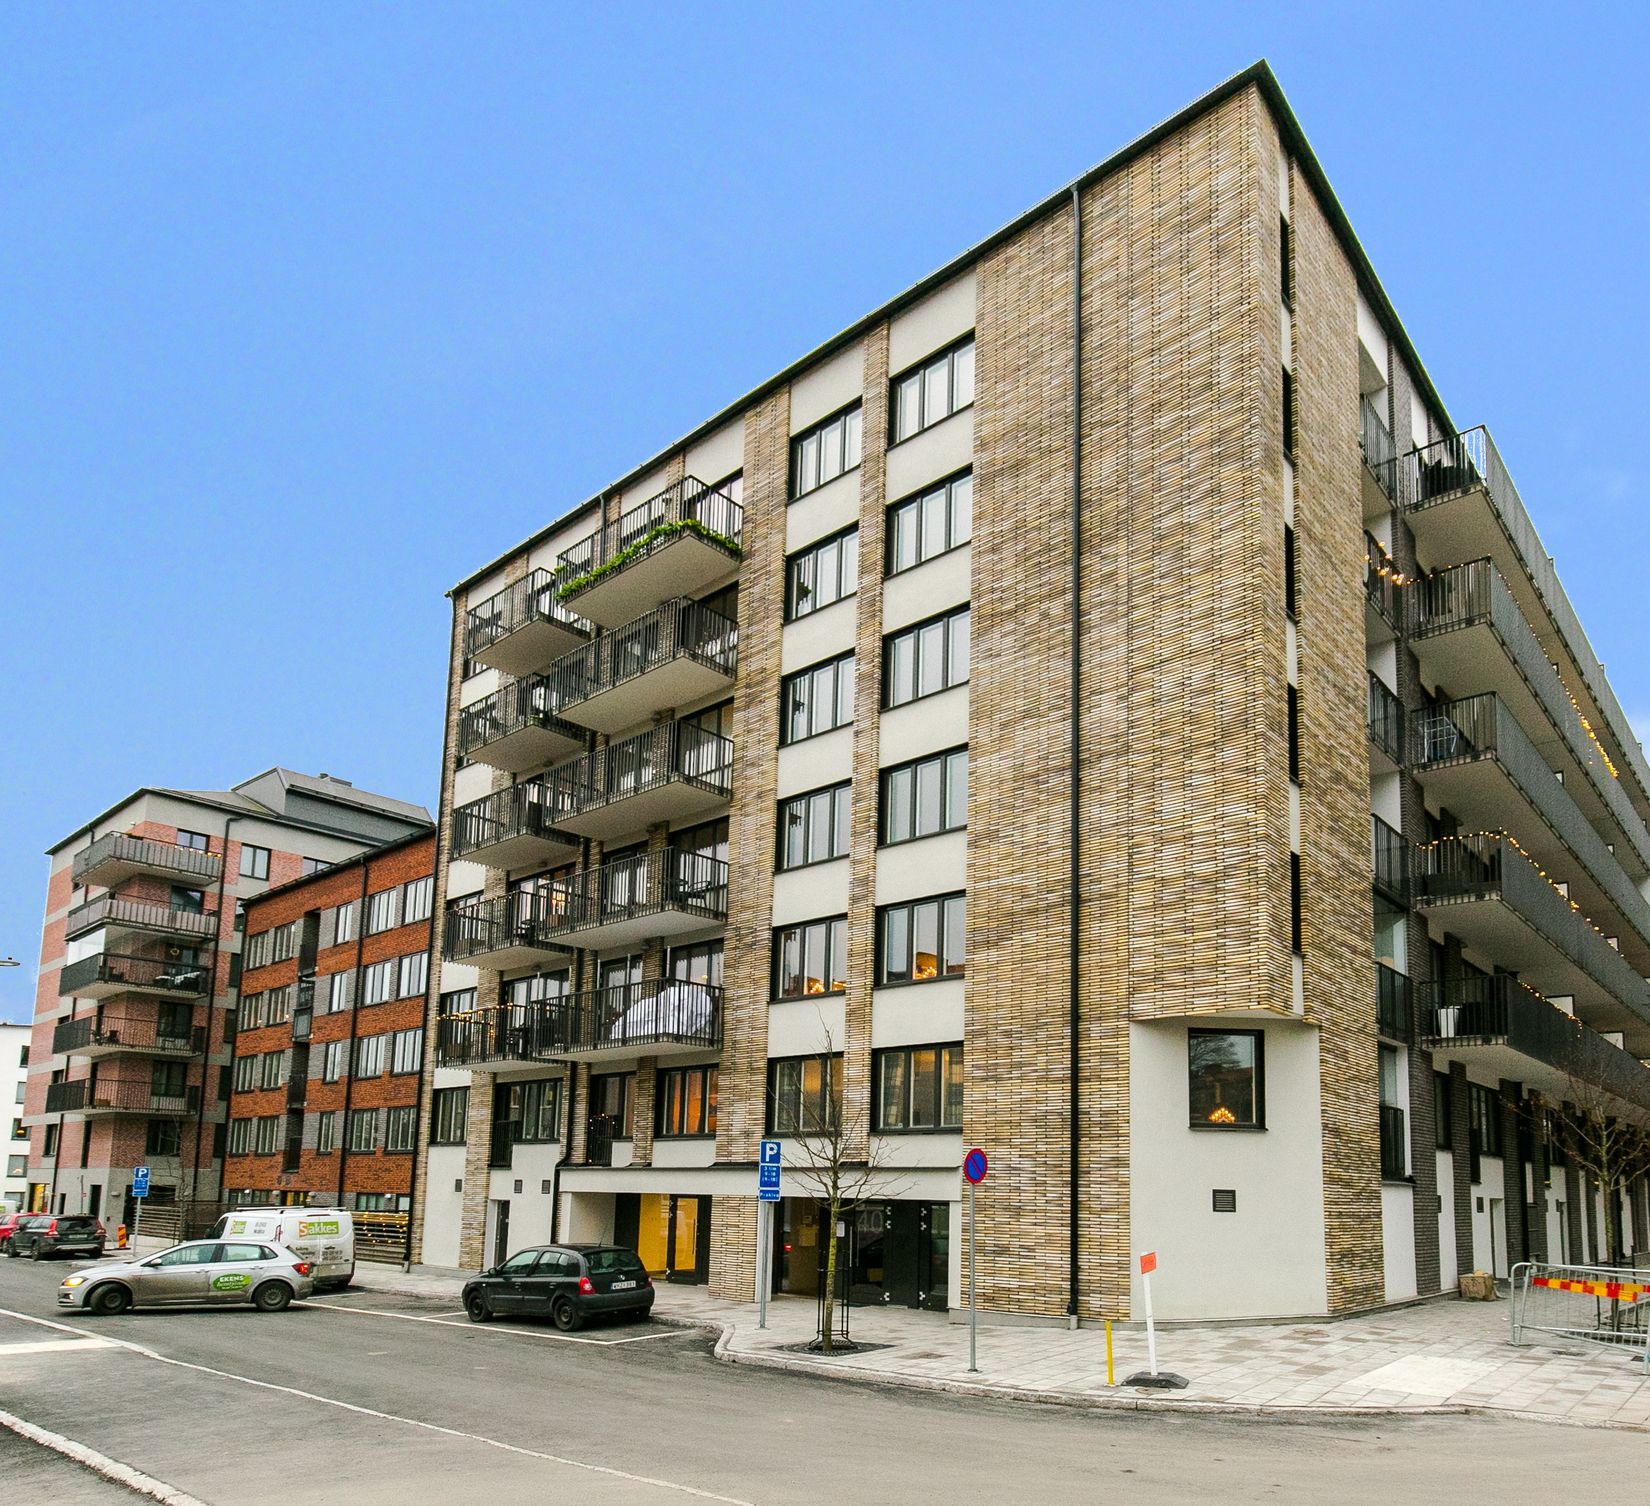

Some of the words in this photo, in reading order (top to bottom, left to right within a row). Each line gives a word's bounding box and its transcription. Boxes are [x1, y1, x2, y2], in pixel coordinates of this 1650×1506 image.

[765, 1143, 778, 1162] P
[138, 1168, 147, 1178] P
[299, 1222, 338, 1236] Sakkes
